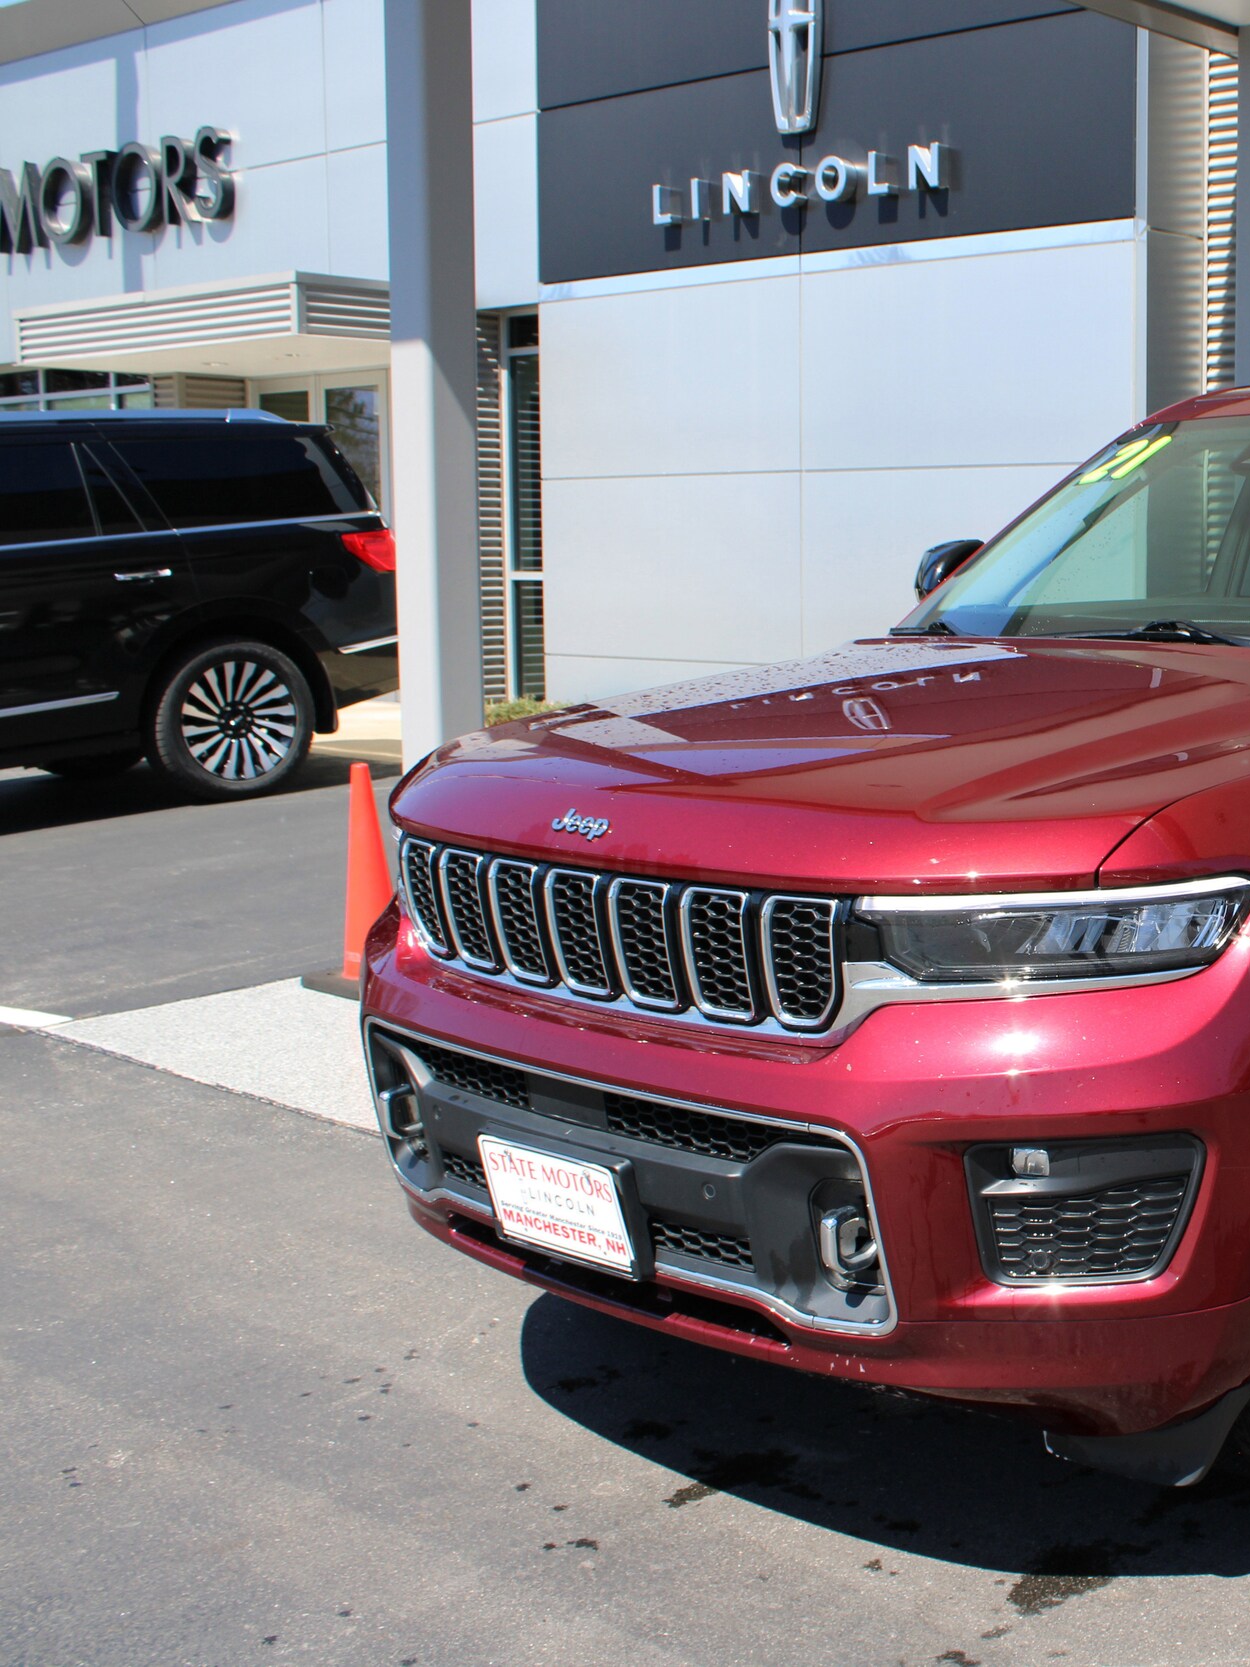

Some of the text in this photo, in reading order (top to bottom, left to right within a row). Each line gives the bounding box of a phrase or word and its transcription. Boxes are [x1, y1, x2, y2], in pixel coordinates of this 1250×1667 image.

[0, 126, 235, 254] MOTORS
[652, 141, 946, 225] LINCOLN
[551, 807, 610, 842] Jeep
[489, 1151, 613, 1203] STATE MOTORS
[501, 1200, 524, 1213] Serving
[525, 1206, 548, 1218] Greater
[550, 1214, 586, 1229] Manchester
[528, 1187, 595, 1216] LINCOLN
[503, 1208, 626, 1256] MANCHESTER, NH
